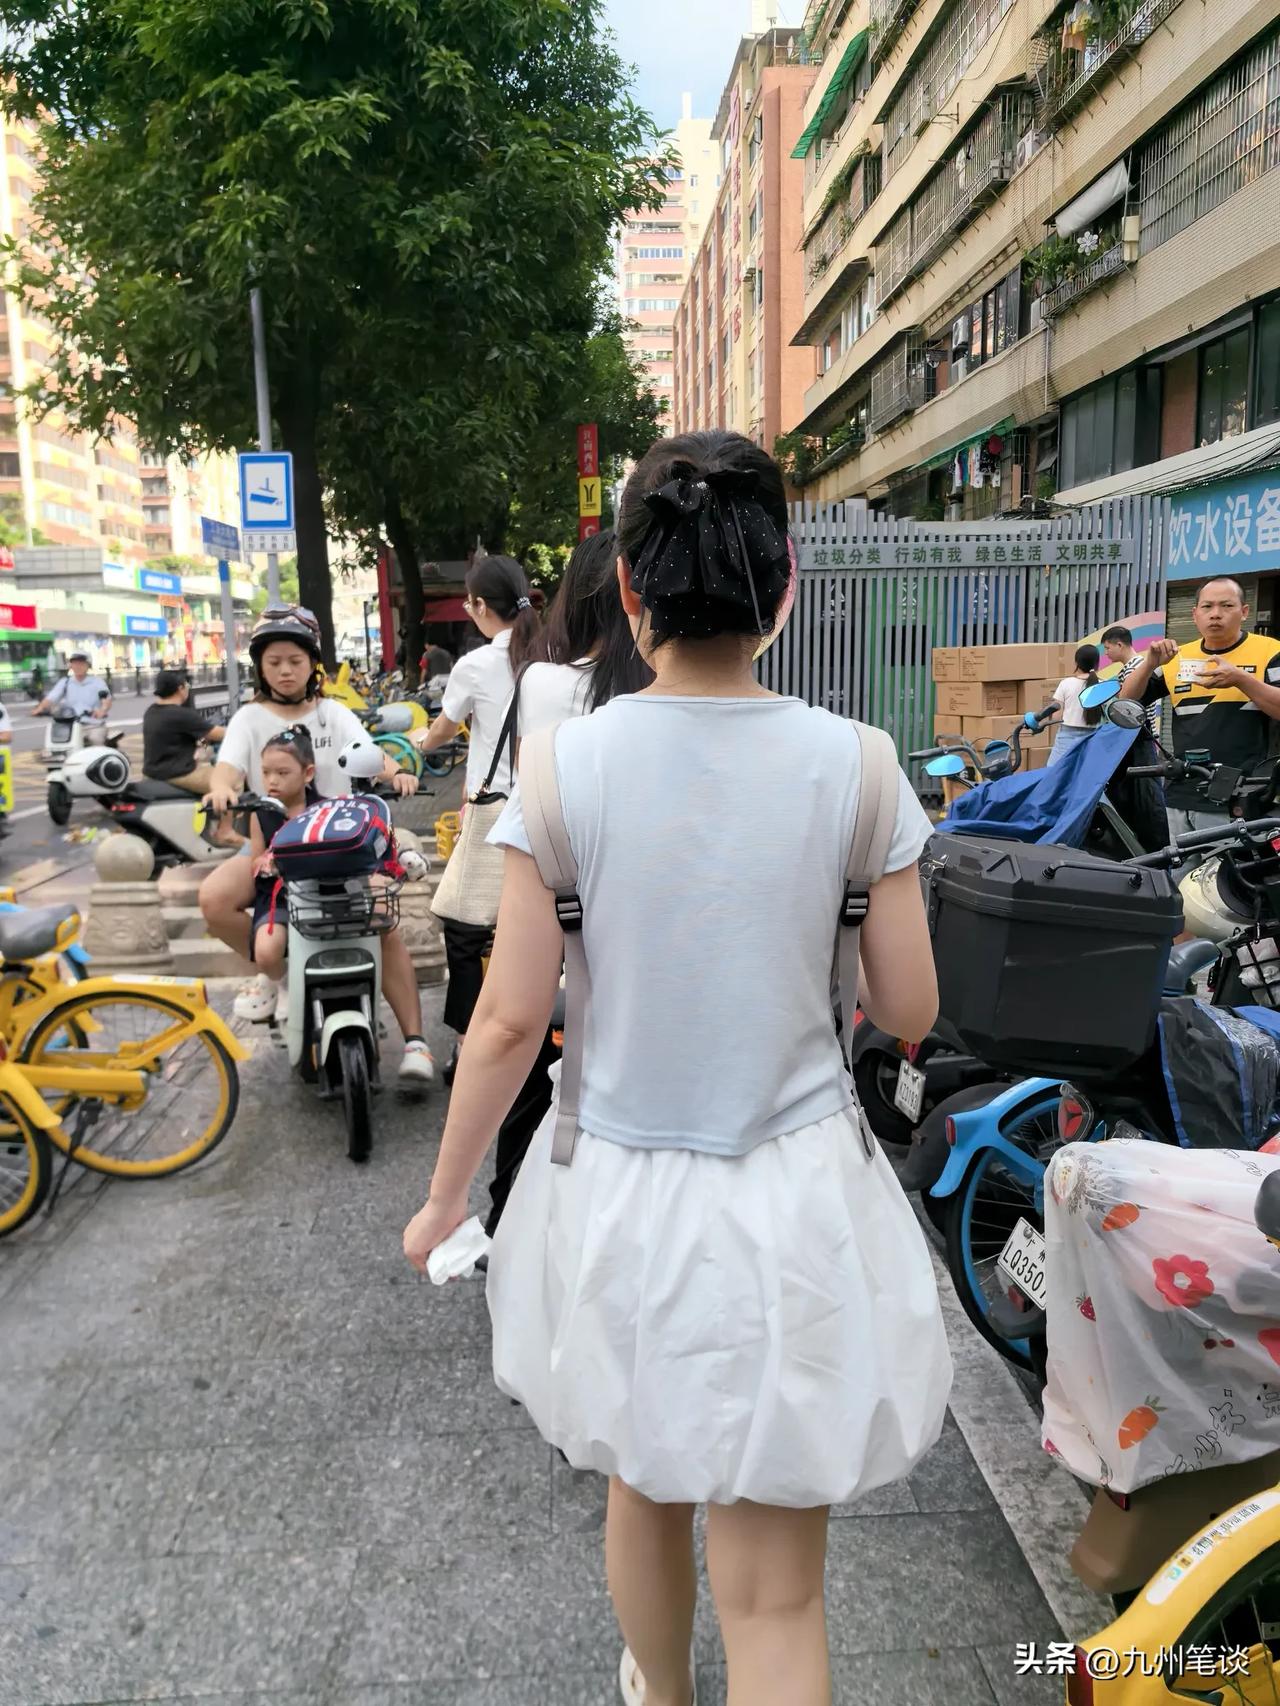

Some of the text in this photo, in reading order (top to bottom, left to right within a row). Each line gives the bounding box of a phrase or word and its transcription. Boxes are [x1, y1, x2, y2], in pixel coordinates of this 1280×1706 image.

[1168, 487, 1280, 566] 饮水设备
[813, 543, 1123, 566] 垃圾分类 行动有我 绿色生活 文明共享
